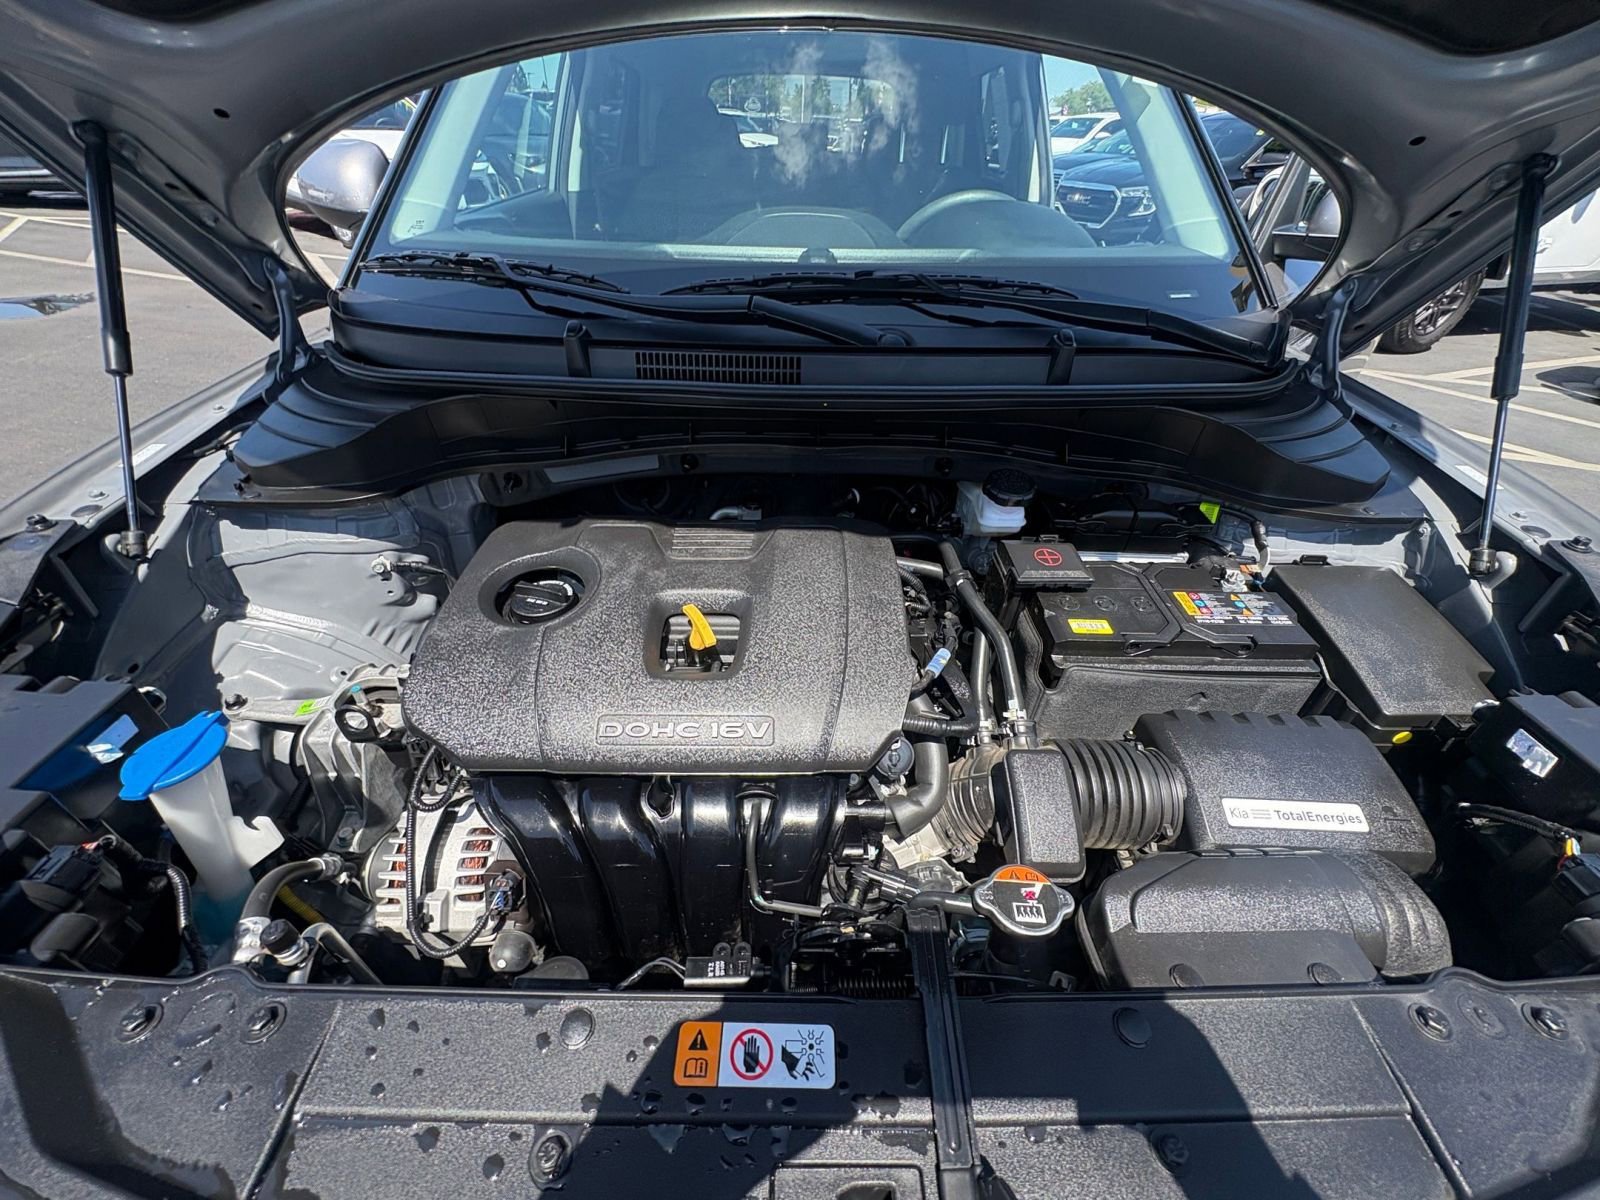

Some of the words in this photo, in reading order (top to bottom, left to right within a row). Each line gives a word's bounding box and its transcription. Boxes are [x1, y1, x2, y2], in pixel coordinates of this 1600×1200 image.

[599, 722, 701, 738] DOHC
[711, 722, 771, 739] 16V
[1229, 807, 1249, 819] Kia
[1273, 810, 1363, 825] TotalEnergies
